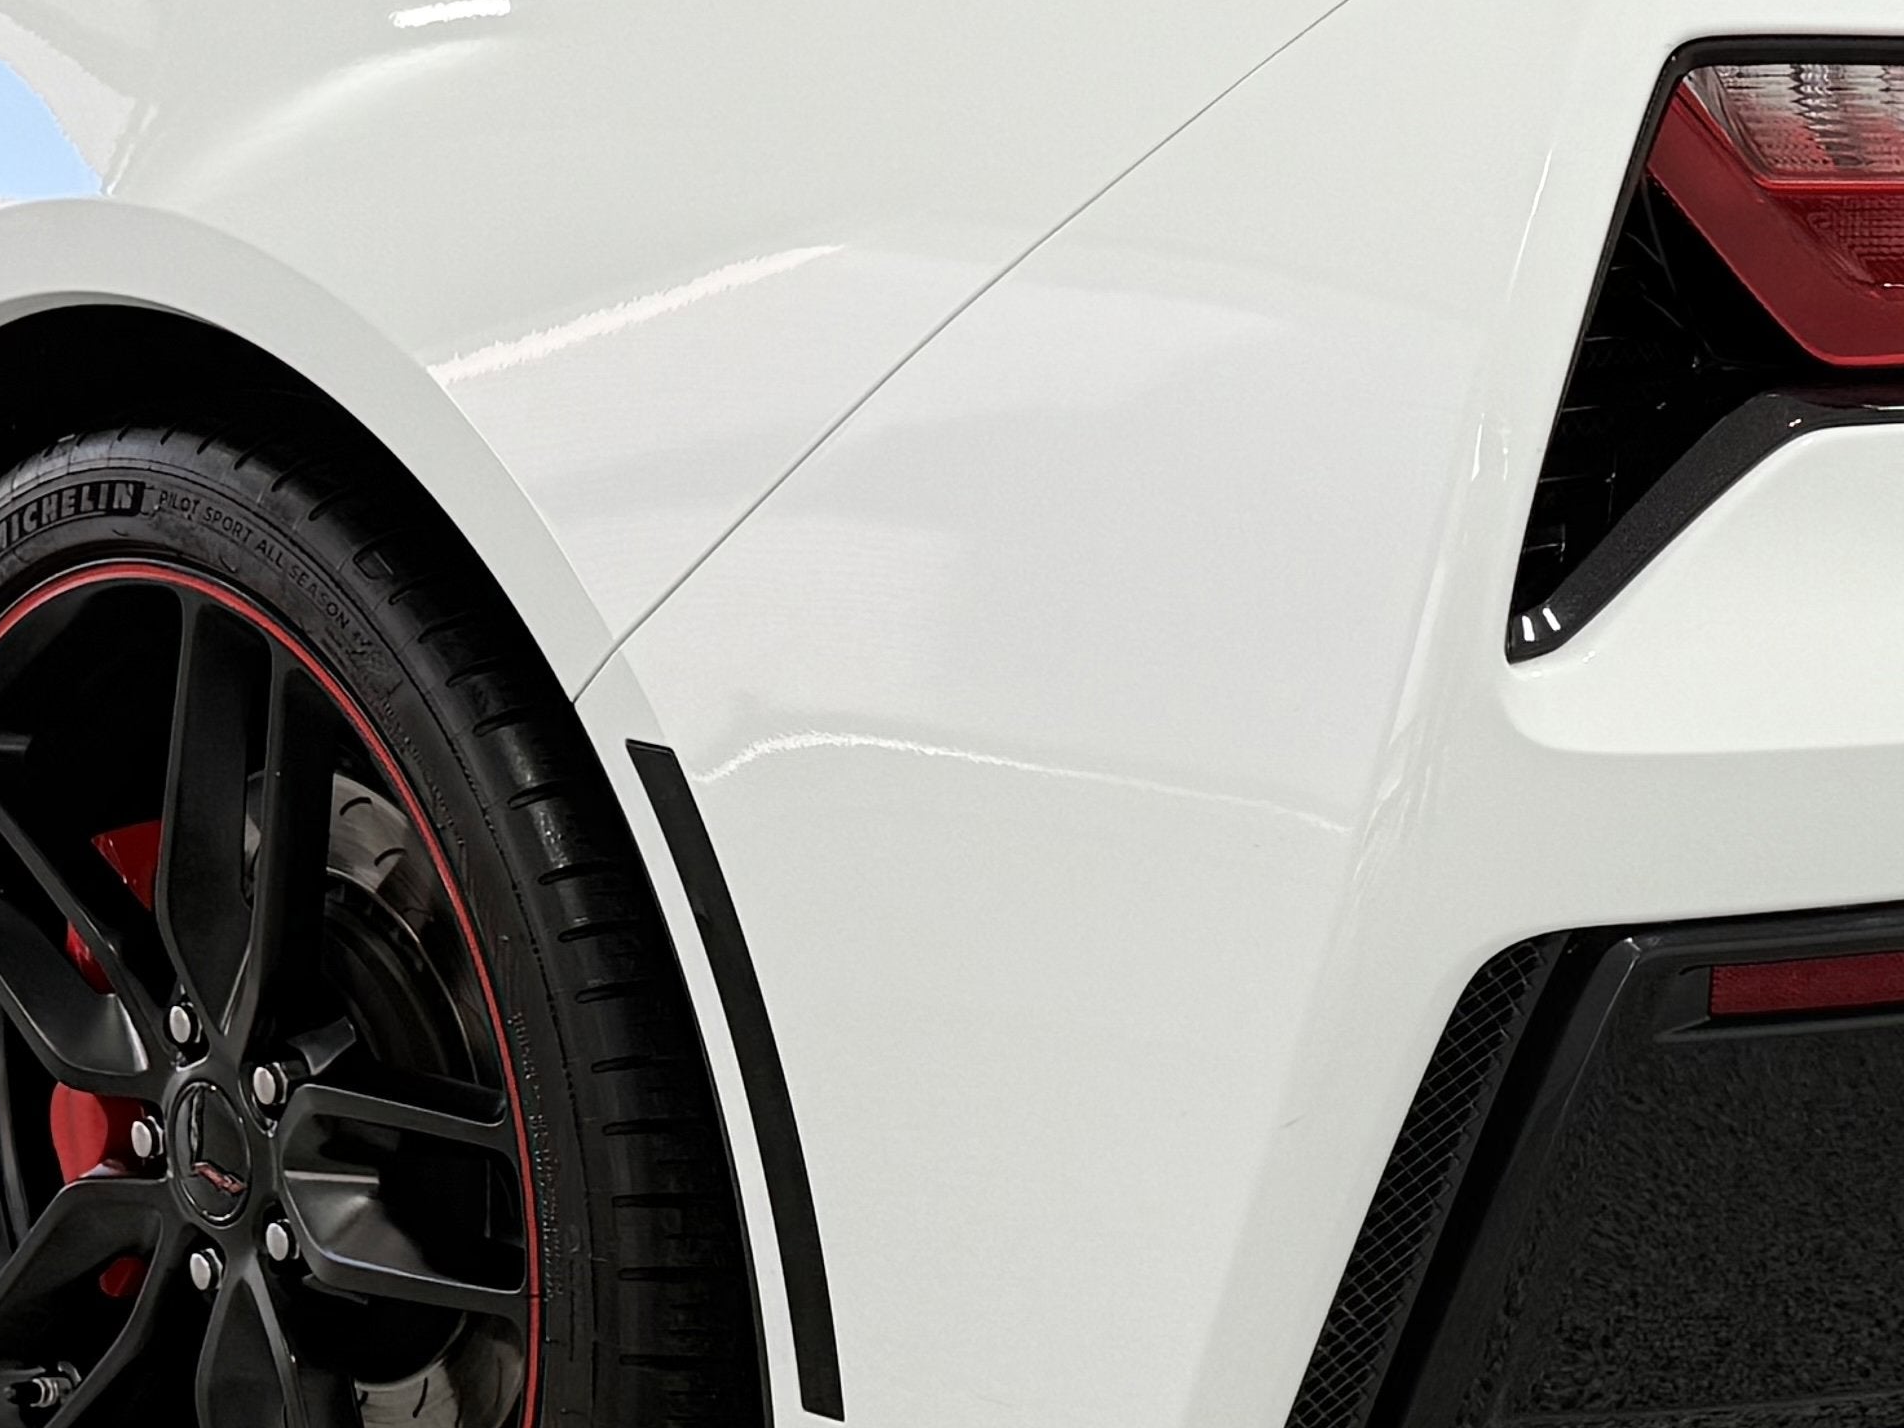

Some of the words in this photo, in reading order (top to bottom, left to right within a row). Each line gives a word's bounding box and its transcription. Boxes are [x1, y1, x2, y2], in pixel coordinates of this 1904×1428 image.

[159, 490, 200, 515] PILOT
[203, 506, 254, 543] SPORT
[255, 538, 284, 568] ALL
[288, 565, 350, 630] SEASON
